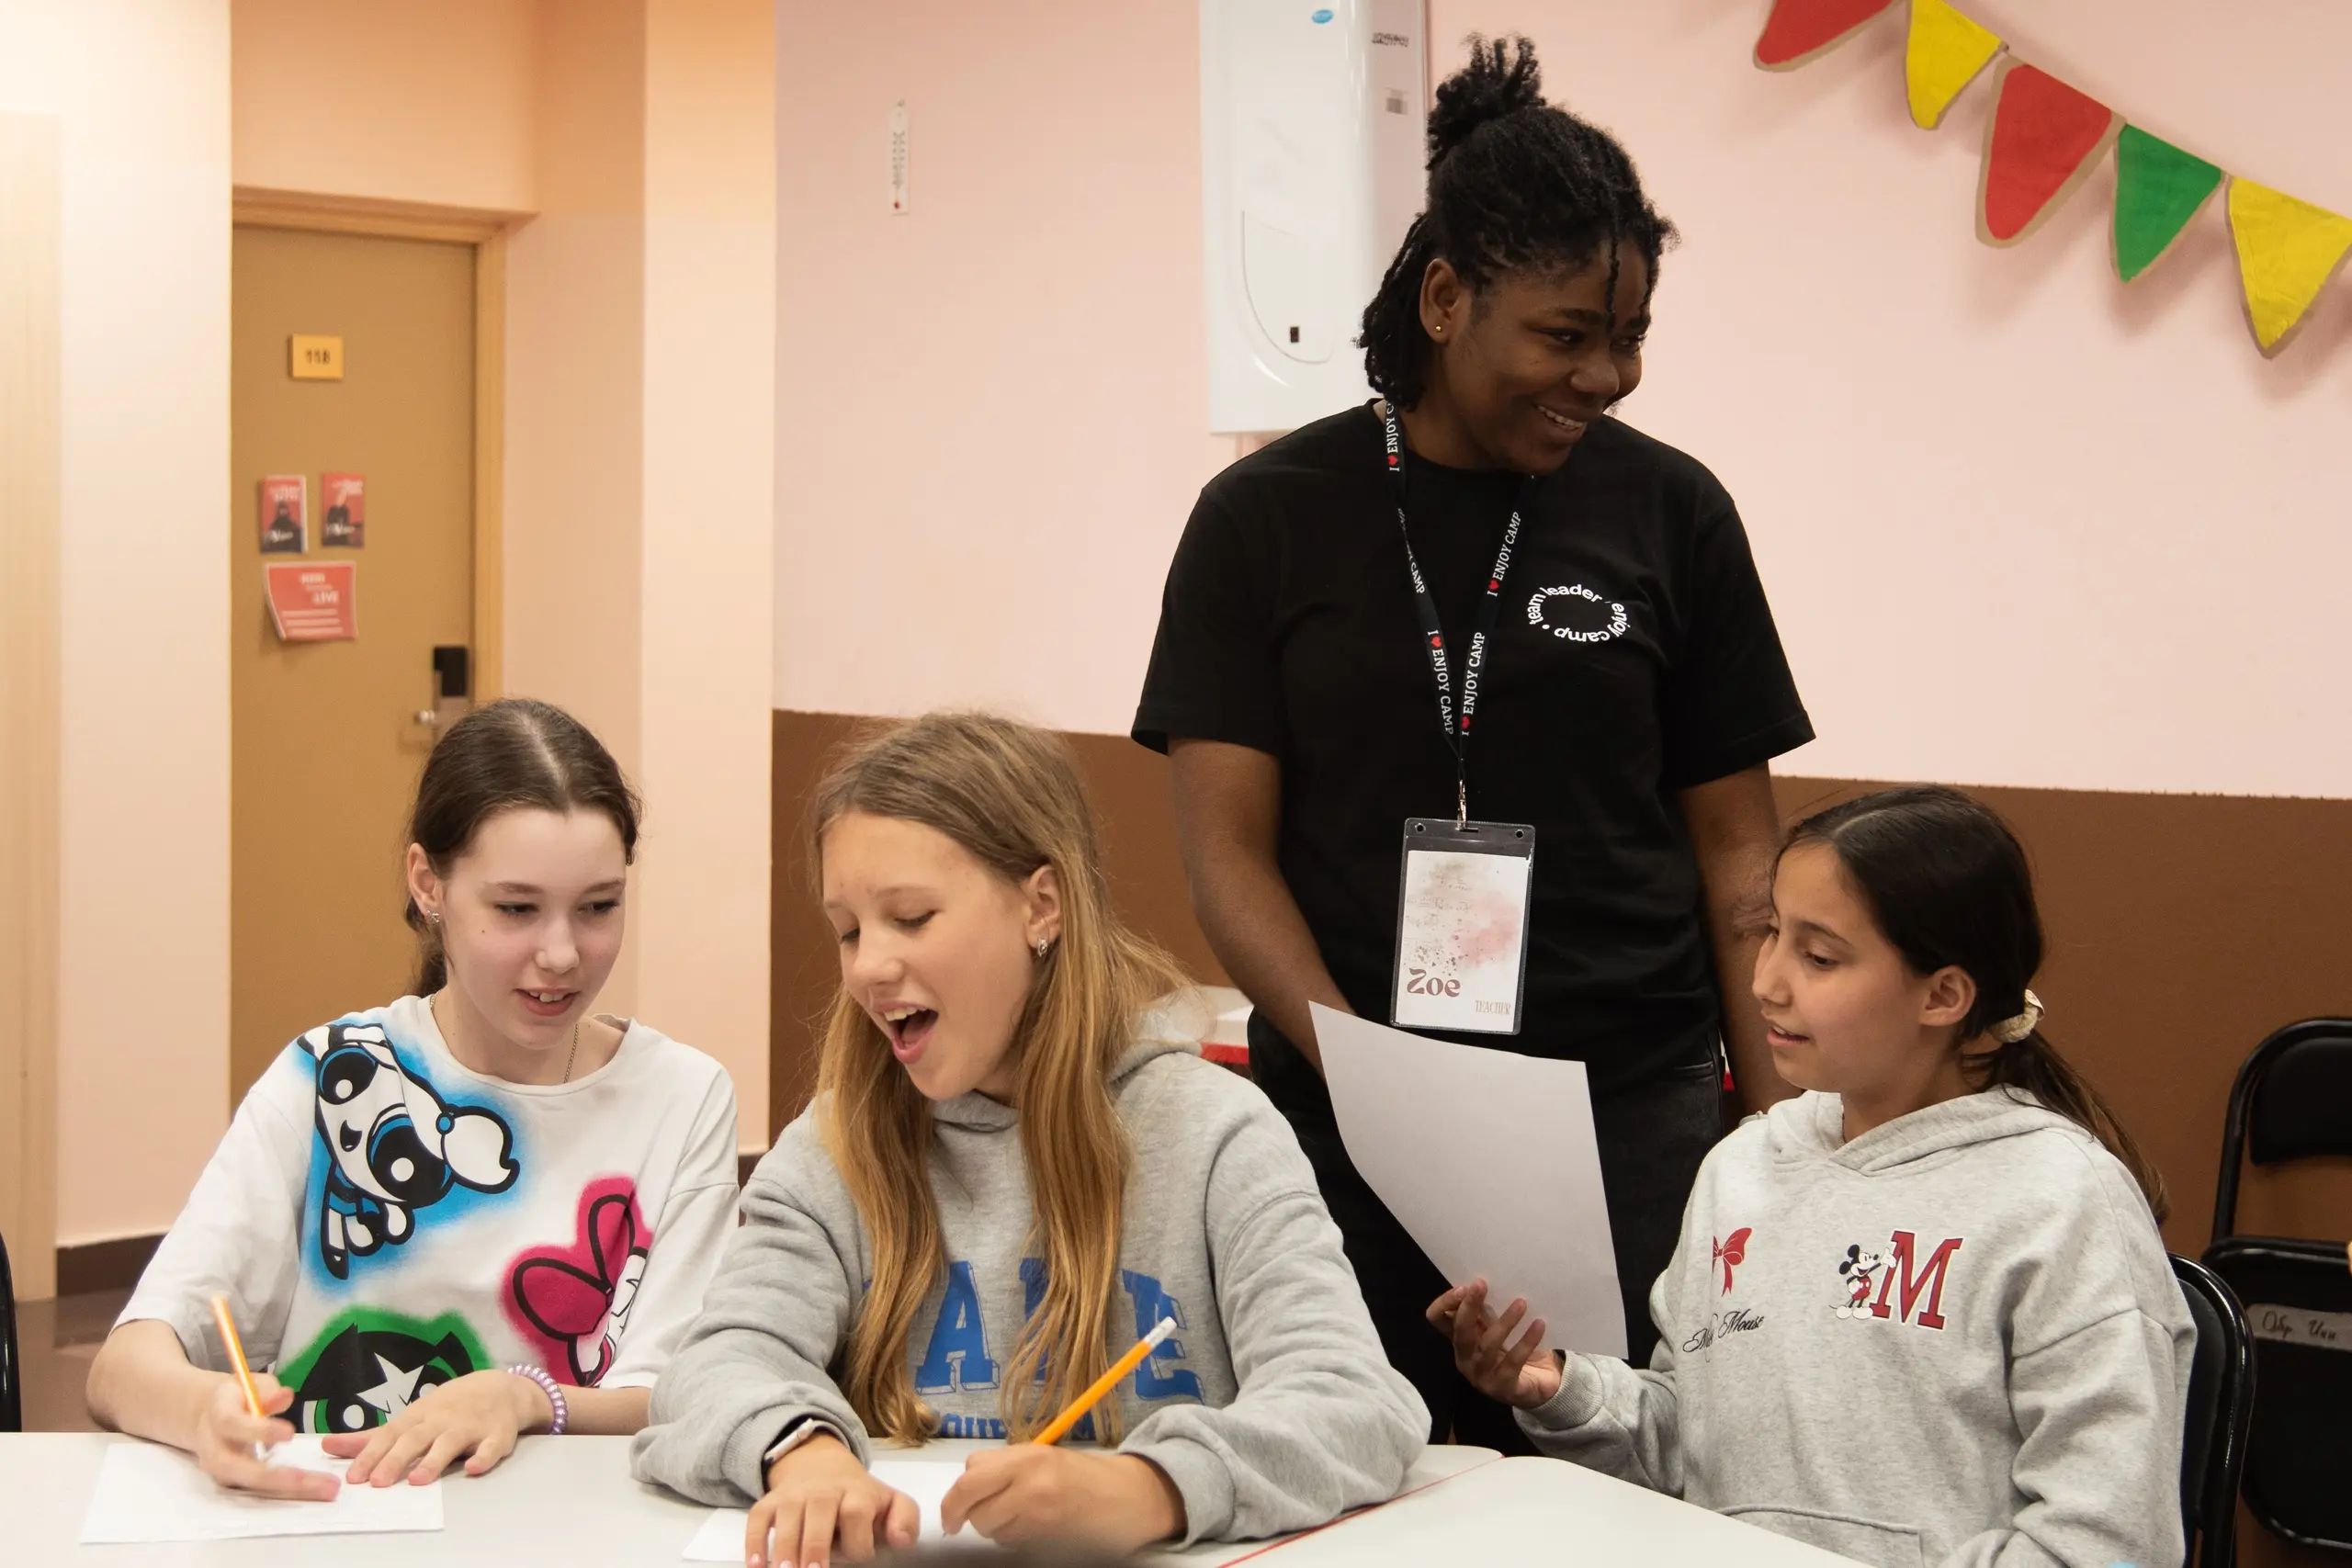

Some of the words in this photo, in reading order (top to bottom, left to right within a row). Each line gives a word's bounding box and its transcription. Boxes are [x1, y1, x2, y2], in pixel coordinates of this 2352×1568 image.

[1385, 417, 1398, 453] ENJOY
[1492, 544, 1512, 581] ENJOY
[1504, 512, 1521, 545] CAMP
[1411, 561, 1425, 593] CAMP
[1527, 593, 1546, 625] team
[1539, 583, 1603, 603] leader
[1607, 603, 1631, 637] enjoy
[1468, 632, 1485, 668] CAMP
[1554, 627, 1611, 642] camp
[1431, 649, 1450, 692] ENJOY
[1463, 670, 1478, 715] ENJOY
[1440, 695, 1453, 735] CAMP
[1407, 967, 1461, 998] Zoe
[1475, 999, 1511, 1015] TEACHER
[1869, 1230, 1964, 1330] M
